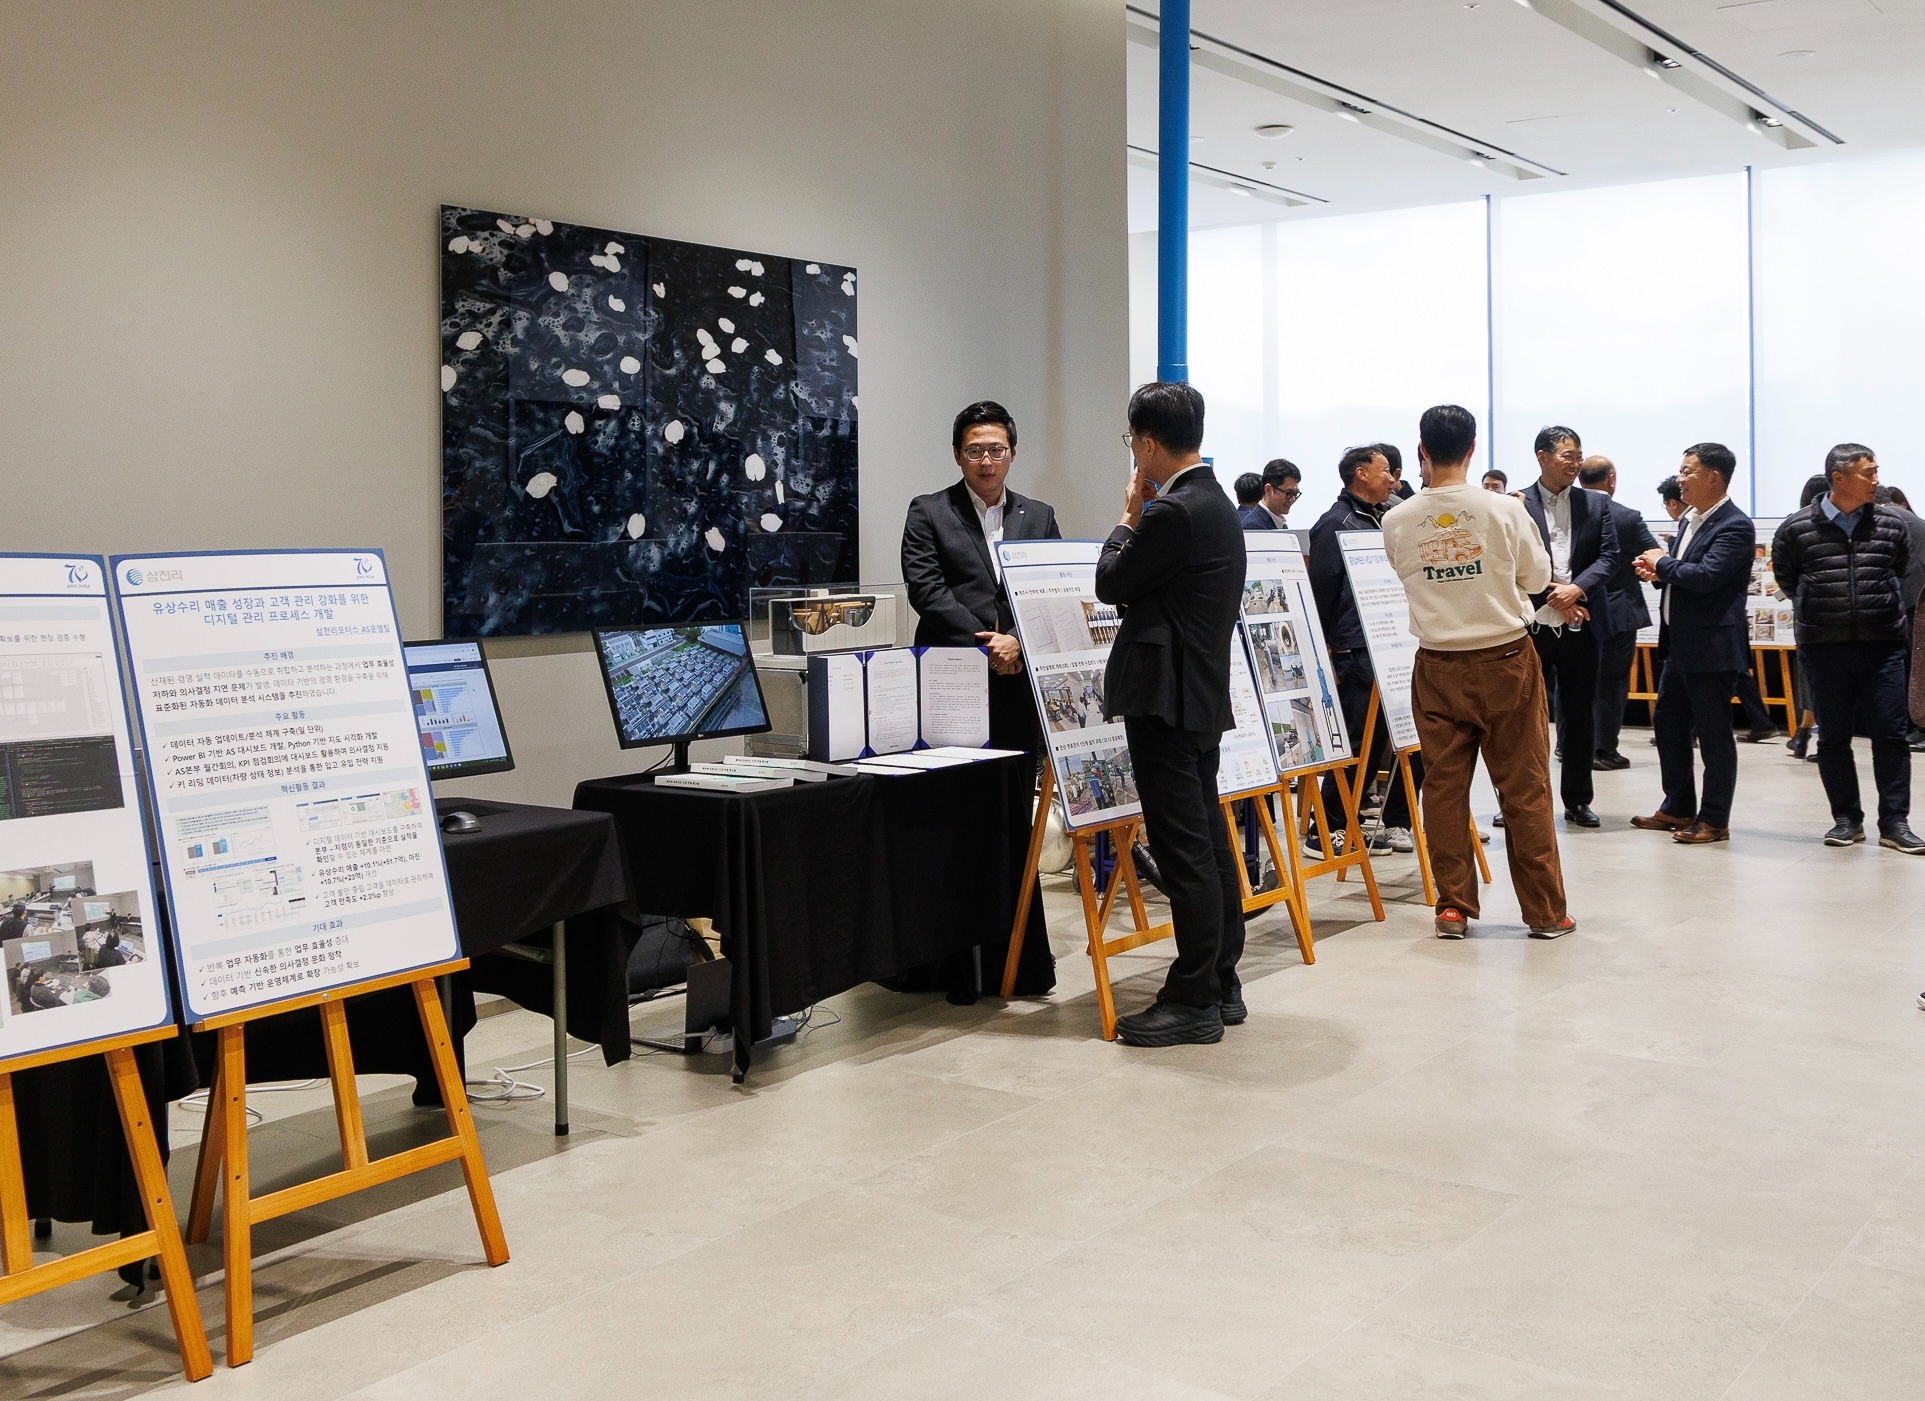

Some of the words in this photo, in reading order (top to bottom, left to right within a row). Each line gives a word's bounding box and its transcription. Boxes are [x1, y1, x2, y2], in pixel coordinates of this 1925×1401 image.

[146, 570, 183, 582] 삼천리
[1423, 560, 1482, 580] Travel
[153, 601, 200, 615] 유상수리
[205, 599, 227, 611] 매출
[232, 597, 265, 610] 성장과
[270, 596, 290, 607] 고객
[294, 595, 314, 606] 관리
[318, 594, 347, 606] 강화를
[351, 593, 369, 604] 위한
[204, 613, 238, 626] 디지털
[242, 612, 264, 624] 관리
[269, 609, 310, 621] 프로세스
[314, 608, 333, 619] 개발
[316, 626, 359, 636] 삼천리모터스
[361, 624, 390, 632] AS운영팀
[264, 652, 277, 660] 추진
[280, 651, 294, 659] 배경
[151, 676, 174, 686] 산재된
[178, 674, 193, 683] 경영
[196, 673, 211, 682] 실적
[213, 670, 243, 680] 데이터를
[246, 668, 274, 677] 수동으로
[277, 665, 305, 675] 취합하고
[306, 663, 333, 673] 분석하는
[335, 662, 360, 670] 과정에서
[362, 660, 375, 668] 업무
[377, 659, 395, 667] 효율성
[153, 690, 177, 699] 저하와
[180, 687, 211, 696] 의사결정
[214, 684, 228, 693] 지연
[231, 682, 253, 691] 문제가
[273, 679, 294, 687] 데이터
[297, 677, 317, 686] 기반의
[319, 676, 332, 684] 경영
[156, 702, 187, 712] 표준화된
[190, 699, 213, 708] 자동화
[216, 697, 238, 706] 데이터
[241, 695, 255, 703] 분석
[258, 692, 286, 701] 시스템을
[275, 713, 289, 721] 주요
[292, 711, 305, 719] 활동
[171, 739, 194, 749] 데이터
[197, 737, 212, 746] 자동
[215, 731, 263, 744] 업데이트/분석
[265, 729, 280, 738] 체계
[282, 726, 305, 736] 구축(일
[307, 724, 324, 734] 단위)
[173, 754, 195, 762] Power
[208, 749, 223, 758] 기반
[226, 748, 236, 756] AS
[238, 743, 267, 754] 대시보드
[287, 740, 311, 749] Python
[313, 737, 326, 746] 기반
[344, 733, 363, 742] 시각화
[365, 731, 378, 740] 개발
[175, 766, 201, 776] AS본부
[252, 754, 289, 765] 점검회의에
[291, 751, 318, 760] 대시보드
[320, 747, 347, 758] 활용하여
[349, 745, 374, 754] 의사결정
[376, 743, 389, 751] 지원
[177, 781, 185, 789] 키
[188, 778, 203, 788] 리딩
[206, 772, 247, 785] 데이터(차량
[250, 770, 265, 779] 상태
[267, 769, 284, 777] 정보)
[286, 765, 307, 775] 분석을
[309, 763, 322, 772] 통한
[325, 761, 338, 770] 입고
[341, 760, 353, 768] 유입
[355, 758, 368, 766] 전략
[371, 756, 383, 764] 지원
[281, 782, 309, 793] 혁신활동
[312, 780, 325, 789] 결과
[319, 865, 344, 877] 유상수리
[346, 863, 358, 871] 매출
[409, 853, 421, 861] 마진
[325, 899, 337, 908] 고객
[312, 922, 327, 932] 기대
[329, 919, 343, 929] 효과
[207, 962, 223, 973] 반복
[226, 957, 241, 968] 업무
[244, 950, 275, 964] 자동화를
[277, 947, 292, 957] 통한
[294, 943, 309, 954] 업무
[311, 938, 333, 950] 효율성
[209, 973, 233, 986] 데이터
[236, 970, 251, 981] 기반
[254, 964, 277, 977] 신속한
[279, 957, 309, 971] 의사결정
[311, 952, 326, 962] 문화
[328, 950, 342, 960] 정착
[211, 989, 228, 1001] 향후
[230, 985, 246, 996] 예측
[249, 980, 264, 991] 기반
[267, 972, 304, 988] 운영체계로
[306, 968, 321, 978] 확장
[323, 962, 344, 974] 가능성
[346, 960, 360, 969] 확보
